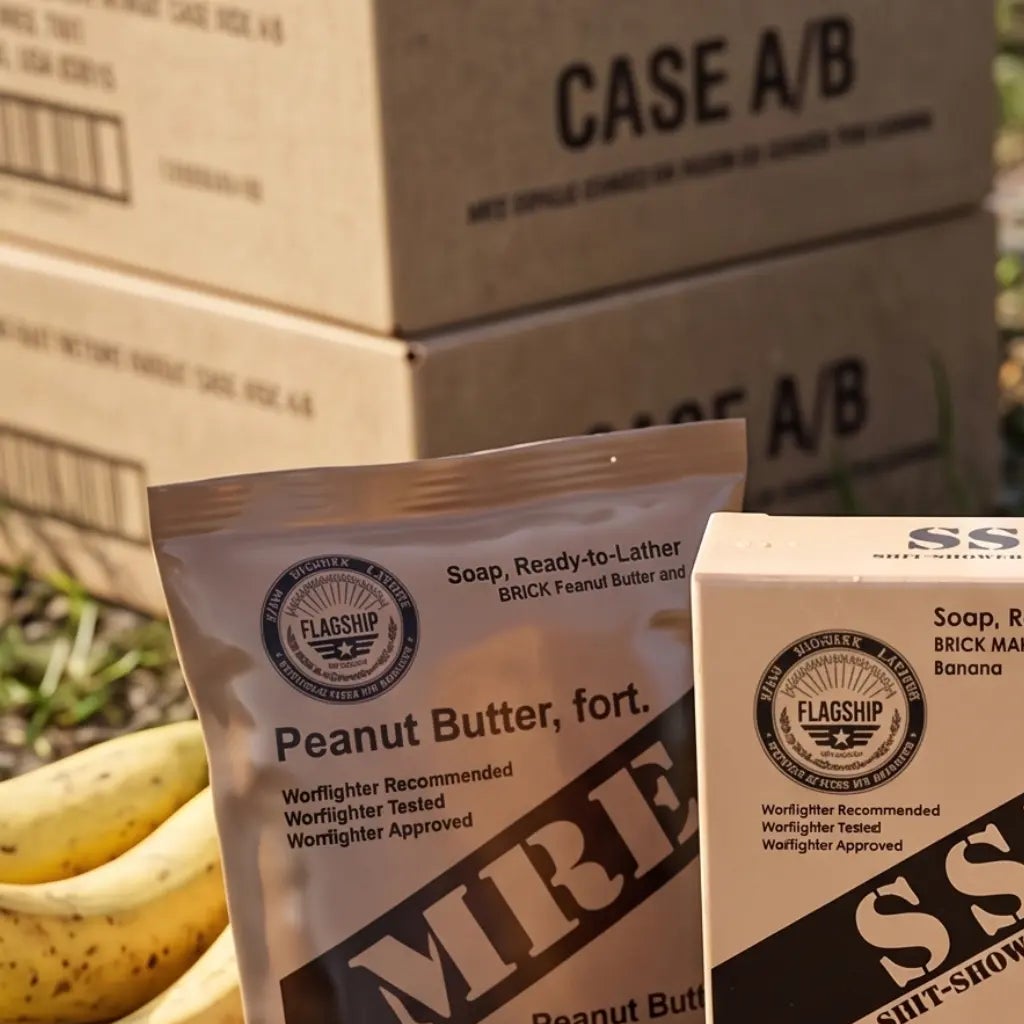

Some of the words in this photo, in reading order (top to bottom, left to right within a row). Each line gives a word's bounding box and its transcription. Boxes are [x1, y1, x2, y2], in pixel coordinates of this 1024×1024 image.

[555, 36, 731, 151] CASE
[749, 15, 856, 115] A/B
[767, 357, 869, 459] A/B
[446, 564, 510, 586] Soap,
[513, 540, 682, 576] Ready-to-Lather
[498, 581, 552, 603] BRICK
[611, 570, 656, 588] Butter
[659, 564, 687, 582] and
[300, 611, 379, 640] FLAGSHIP
[933, 607, 1000, 631] Soap,
[934, 637, 986, 653] BRICK
[934, 660, 1003, 676] Banana
[275, 713, 421, 762] Peanut
[431, 701, 562, 743] Butter,
[573, 682, 651, 723] fort.
[798, 700, 883, 723] FLAGSHIP
[384, 761, 514, 794] Recommended
[388, 793, 446, 816] Tested
[837, 803, 941, 817] Recommended
[388, 811, 473, 841] Approved
[837, 821, 882, 834] Tested
[835, 839, 904, 854] Approved
